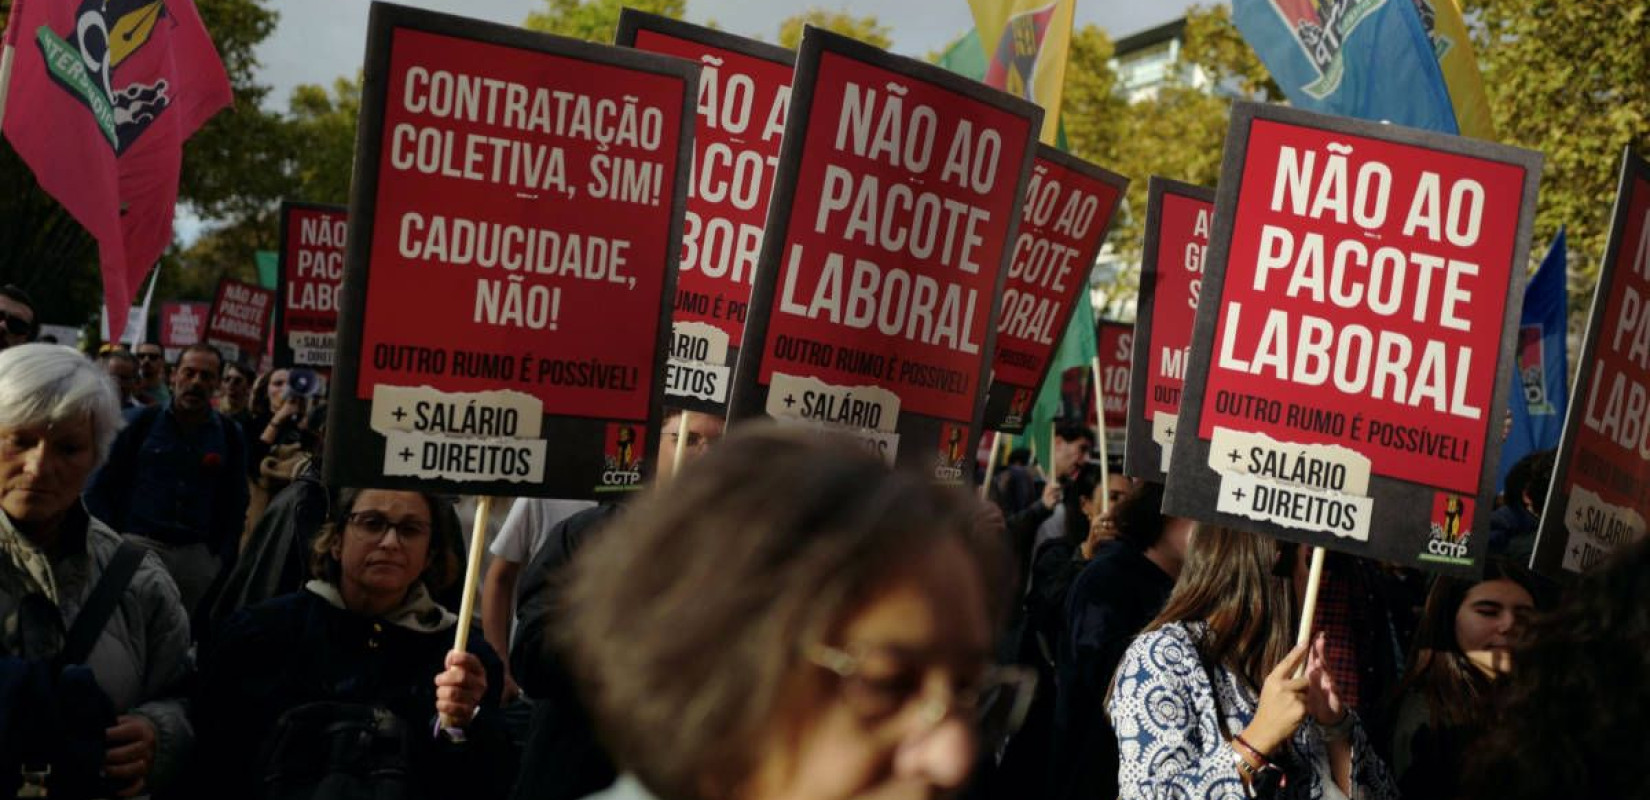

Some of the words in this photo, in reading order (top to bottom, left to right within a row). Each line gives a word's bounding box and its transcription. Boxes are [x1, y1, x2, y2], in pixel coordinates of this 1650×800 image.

[403, 66, 663, 151] CONTRATAÇÃO
[697, 54, 755, 135] ÃO
[761, 85, 792, 143] A
[391, 124, 576, 199] COLETIVA,
[588, 153, 663, 206] SIM!
[835, 82, 938, 174] NÃO
[942, 119, 1002, 195] AO
[815, 164, 991, 275] PACOTE
[1023, 165, 1061, 227] ÃO
[1053, 187, 1099, 240] AO
[1270, 142, 1393, 229] NÃO
[1402, 171, 1486, 247] AO
[297, 251, 342, 279] PAC
[398, 213, 637, 290] CADUCIDADE,
[1008, 232, 1080, 294] COTE
[1253, 223, 1480, 331] PACOTE
[473, 275, 562, 331] NÃO!
[780, 244, 980, 355] LABORAL
[997, 289, 1062, 345] ORAL
[374, 343, 446, 374] OUTRO
[451, 351, 514, 382] RUMO
[520, 353, 535, 383] É
[538, 356, 638, 391] POSSÍVEL!
[668, 327, 709, 362] ÁRIO
[773, 334, 833, 368] OUTRO
[836, 349, 884, 380] RUMO
[887, 355, 898, 381] É
[1217, 301, 1482, 420] LABORAL
[664, 364, 717, 397] EITOS
[1154, 385, 1181, 404] OUT
[414, 399, 518, 437] SALÁRIO
[800, 390, 882, 429] SALÁRIO
[1215, 390, 1281, 425] OUTRO
[1286, 404, 1345, 437] RUMO
[1350, 411, 1363, 440] É
[1367, 421, 1470, 463] POSSÍVEL!
[421, 441, 531, 477] DIREITOS
[603, 470, 641, 486] CGTP
[1247, 447, 1347, 491] SALÁRIO
[1252, 485, 1358, 532] DIREITOS
[1427, 537, 1468, 559] CGTP
